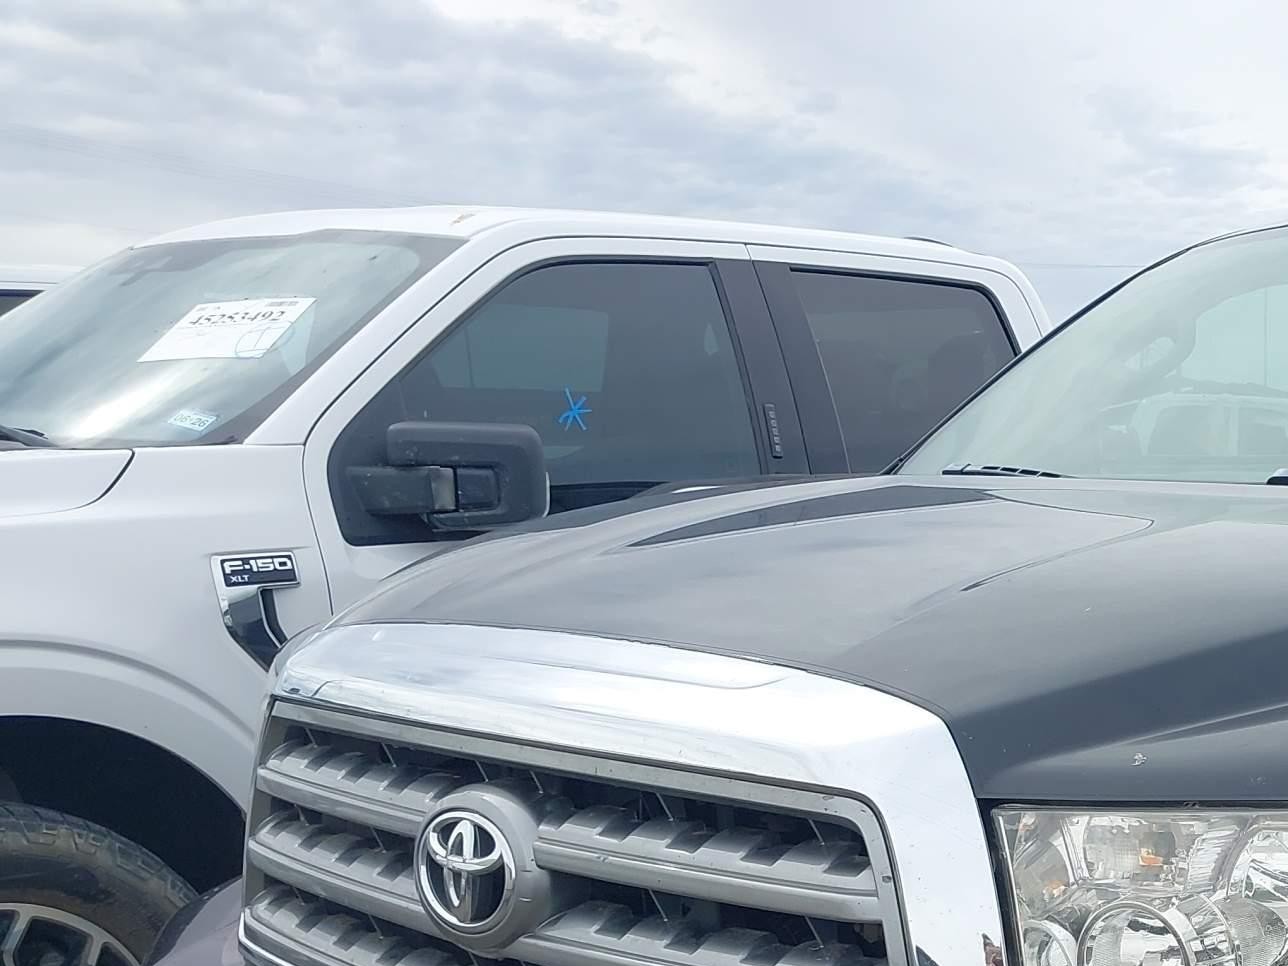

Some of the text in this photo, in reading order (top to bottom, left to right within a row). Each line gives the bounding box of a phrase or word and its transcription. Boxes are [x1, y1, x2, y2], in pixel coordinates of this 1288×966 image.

[190, 310, 286, 325] 45253492
[223, 558, 293, 574] F-150
[230, 575, 250, 583] XLT
